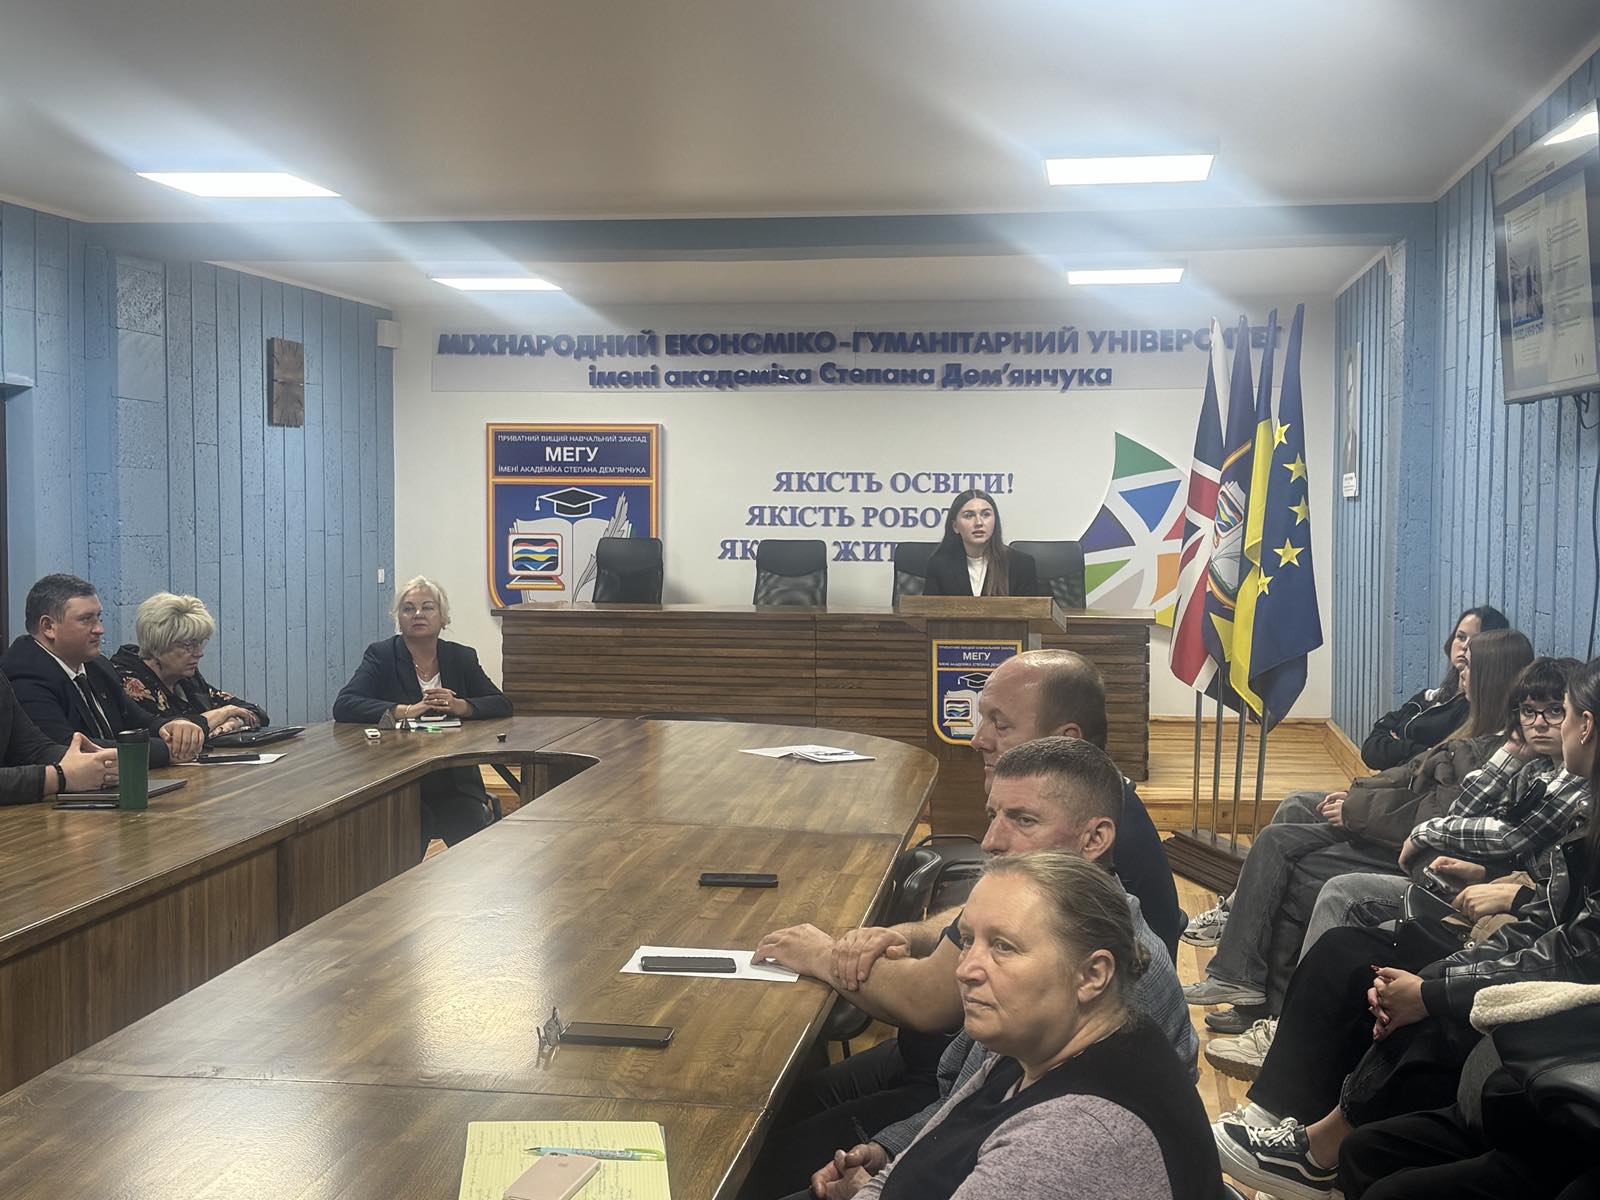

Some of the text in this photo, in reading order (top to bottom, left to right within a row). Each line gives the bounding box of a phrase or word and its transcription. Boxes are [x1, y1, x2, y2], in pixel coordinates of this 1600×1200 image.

[437, 329, 659, 360] МІЖНАРОДНИЙ
[665, 326, 1079, 355] ЕКОНОМІКО-ГУМАНІТАРНИЙ
[588, 364, 659, 388] імені
[664, 363, 812, 389] академіка
[819, 362, 935, 386] Степана
[498, 434, 647, 443] ПРИВАТНИЙ ВИЩИЙ НАВЧАЛЬНИЙ ЗАКЛАД
[545, 446, 599, 462] МЕГУ
[772, 471, 1014, 494] ЯКІСТЬ ОСВІТИ!
[745, 505, 855, 527] ЯКІСТЬ
[963, 652, 991, 661] МЕГУ
